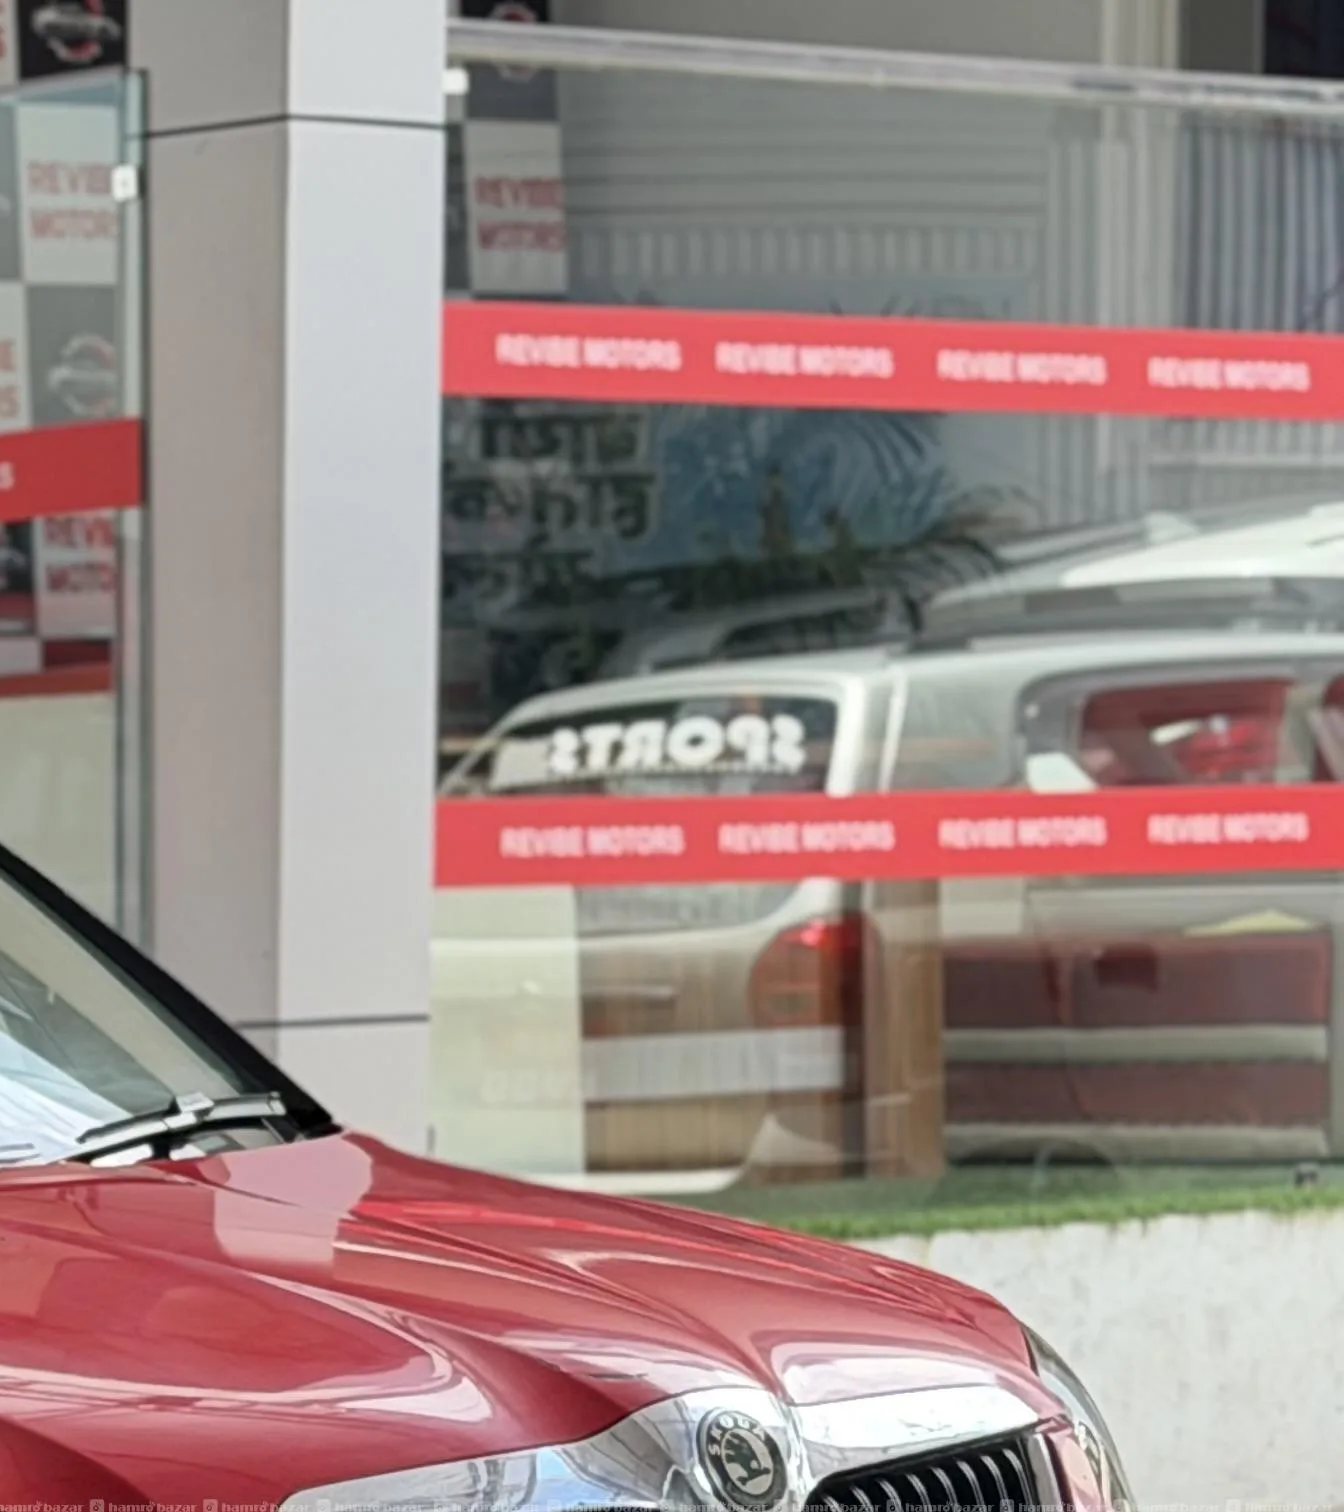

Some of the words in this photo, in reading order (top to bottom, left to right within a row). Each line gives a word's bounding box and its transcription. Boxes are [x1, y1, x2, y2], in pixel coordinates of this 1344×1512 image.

[27, 162, 112, 195] REVIB
[495, 333, 580, 367] REVIBE
[583, 337, 682, 371] MOTORS
[715, 341, 796, 375] REVIBE
[799, 345, 894, 378] MOTORS
[936, 349, 1015, 382] REVIBE
[1017, 352, 1107, 386] MOTORS
[1147, 356, 1221, 389] REVIBE
[1224, 359, 1310, 392] MOTORS
[500, 826, 583, 859] REVIBE
[587, 825, 684, 857] MOTORS
[718, 821, 799, 854] REVIBE
[801, 820, 895, 852] MOTORS
[938, 817, 1015, 850] REVIBE
[1017, 815, 1107, 847] MOTORS
[1147, 813, 1221, 846] REVIBE
[1224, 812, 1310, 844] MOTORS
